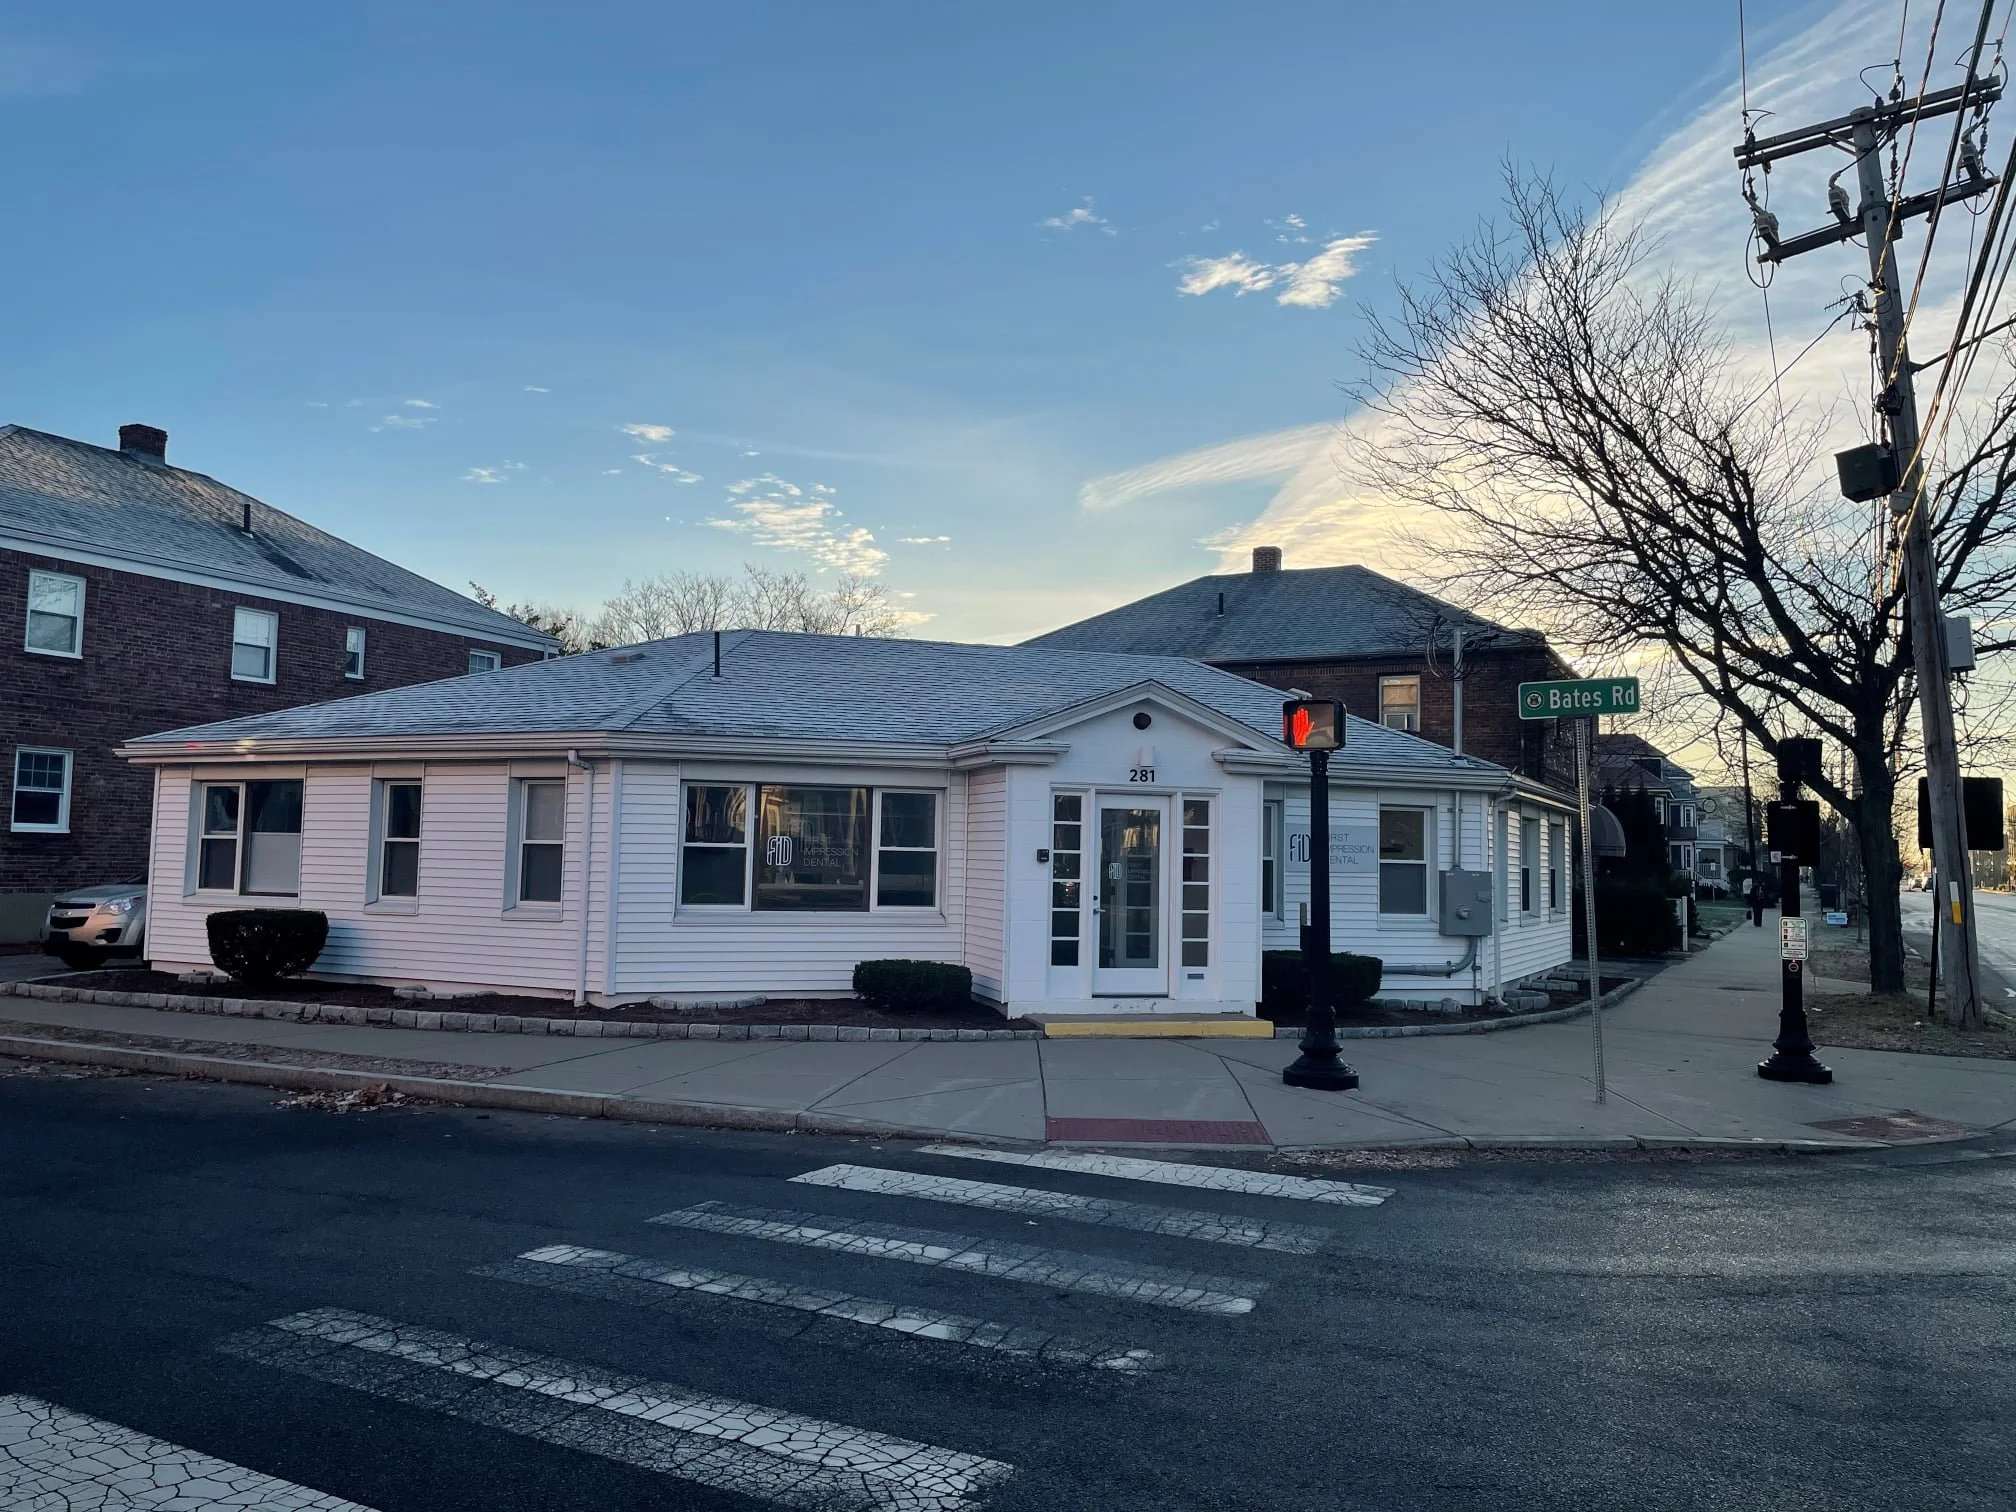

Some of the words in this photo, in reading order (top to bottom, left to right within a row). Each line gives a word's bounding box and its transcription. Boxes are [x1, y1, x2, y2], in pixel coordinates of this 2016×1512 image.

[1549, 688, 1602, 709] Bates
[1612, 685, 1635, 706] Rd
[1129, 769, 1155, 782] 281
[1330, 833, 1349, 842] RST
[803, 847, 859, 857] IMPRESSION
[1329, 844, 1374, 854] PRESSION
[803, 857, 841, 867] DENTAL
[1329, 855, 1359, 865] ENTAL
